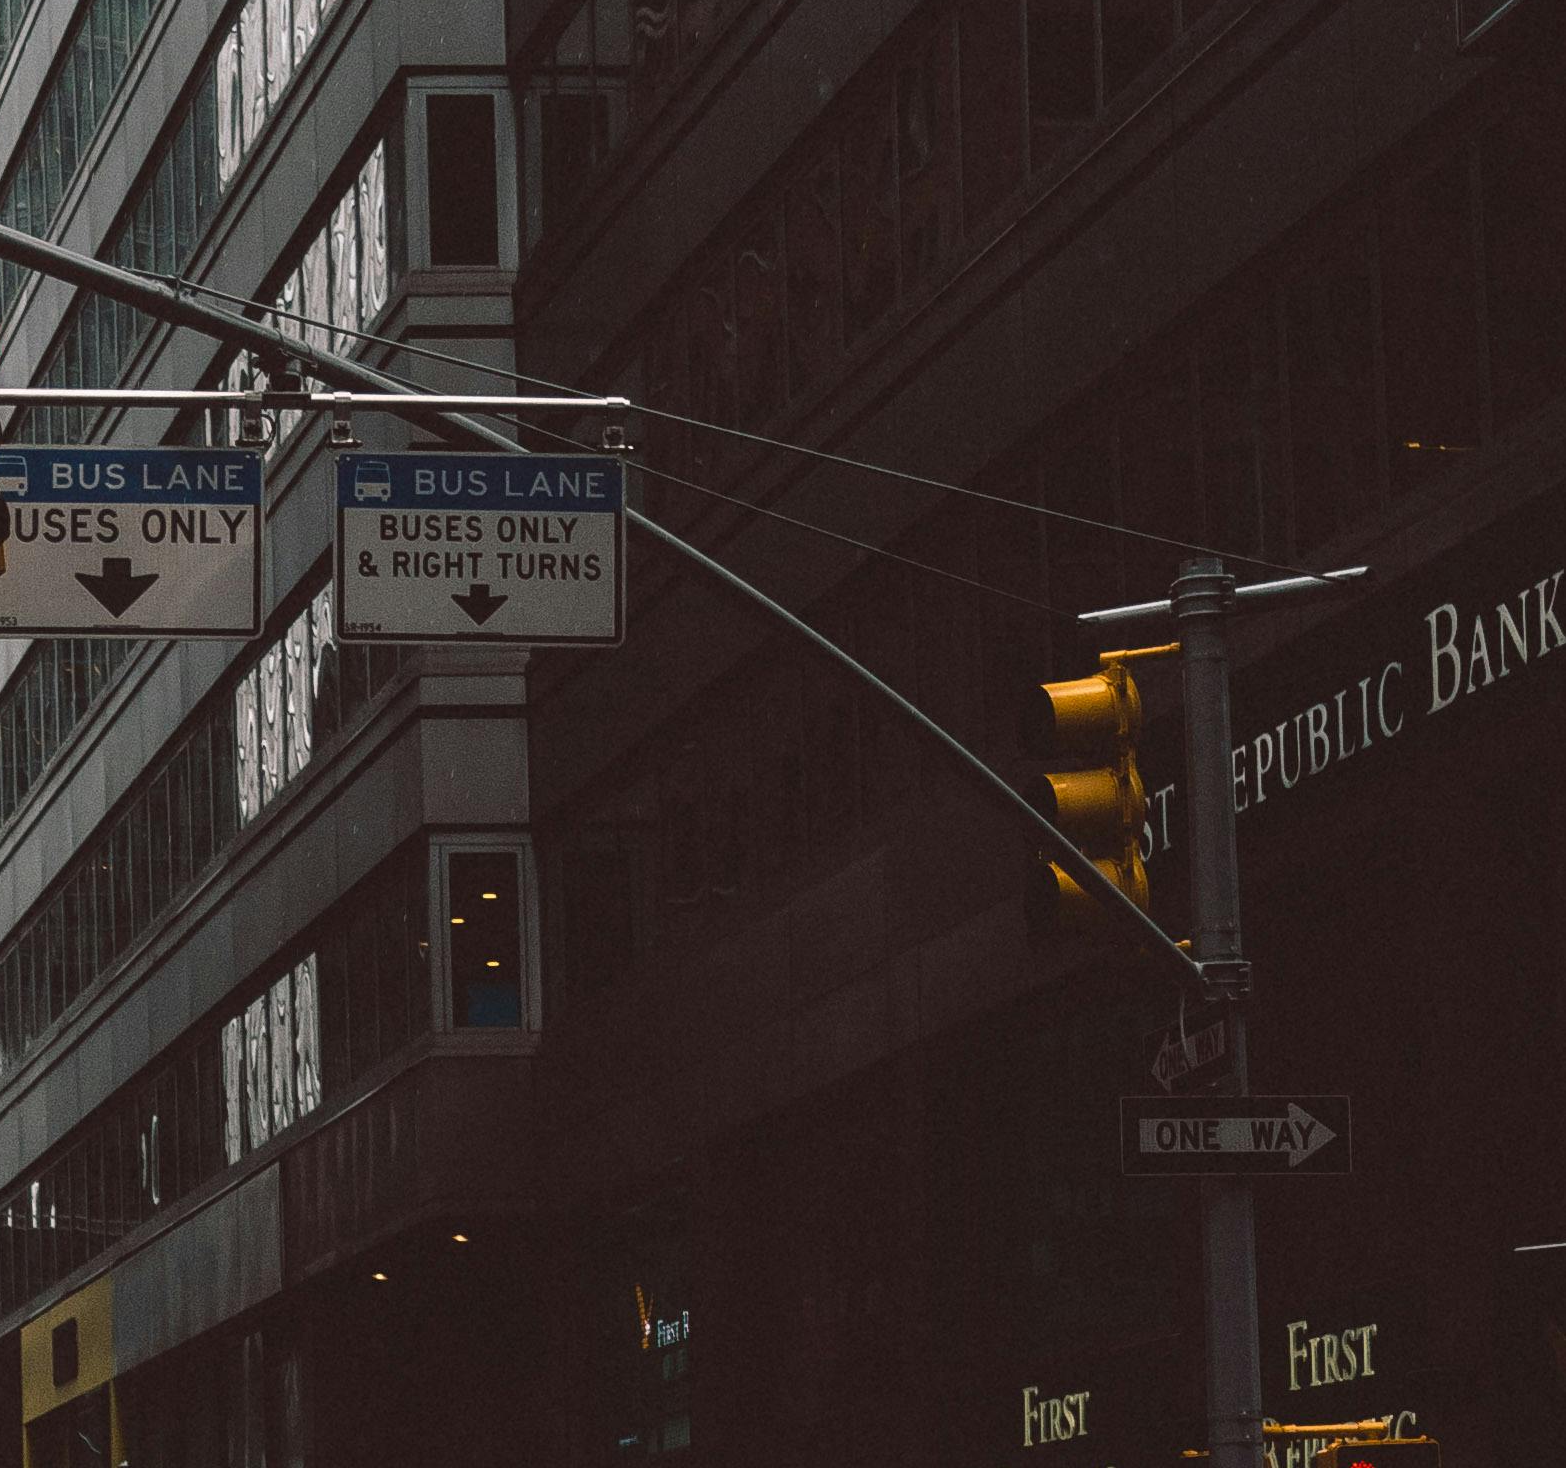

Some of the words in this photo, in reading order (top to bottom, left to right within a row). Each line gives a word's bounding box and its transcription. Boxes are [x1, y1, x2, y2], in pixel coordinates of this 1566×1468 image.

[51, 463, 126, 490] BUS
[142, 464, 245, 492] LANE
[414, 469, 488, 497] BUS
[505, 470, 606, 499] LANE
[14, 508, 120, 544] USES
[141, 509, 248, 545] ONLY
[379, 514, 484, 542] BUSES
[496, 516, 579, 544] ONLY
[358, 550, 380, 577] &
[392, 551, 483, 579] RIGHT
[496, 553, 602, 581] TURNS
[1231, 661, 1405, 813] EPUBLIC
[1424, 569, 1566, 716] BANK
[1155, 1120, 1221, 1152] ONE
[1250, 1120, 1317, 1151] WAY
[1286, 1320, 1378, 1391] FIRST
[1021, 1385, 1090, 1448] FIRST
